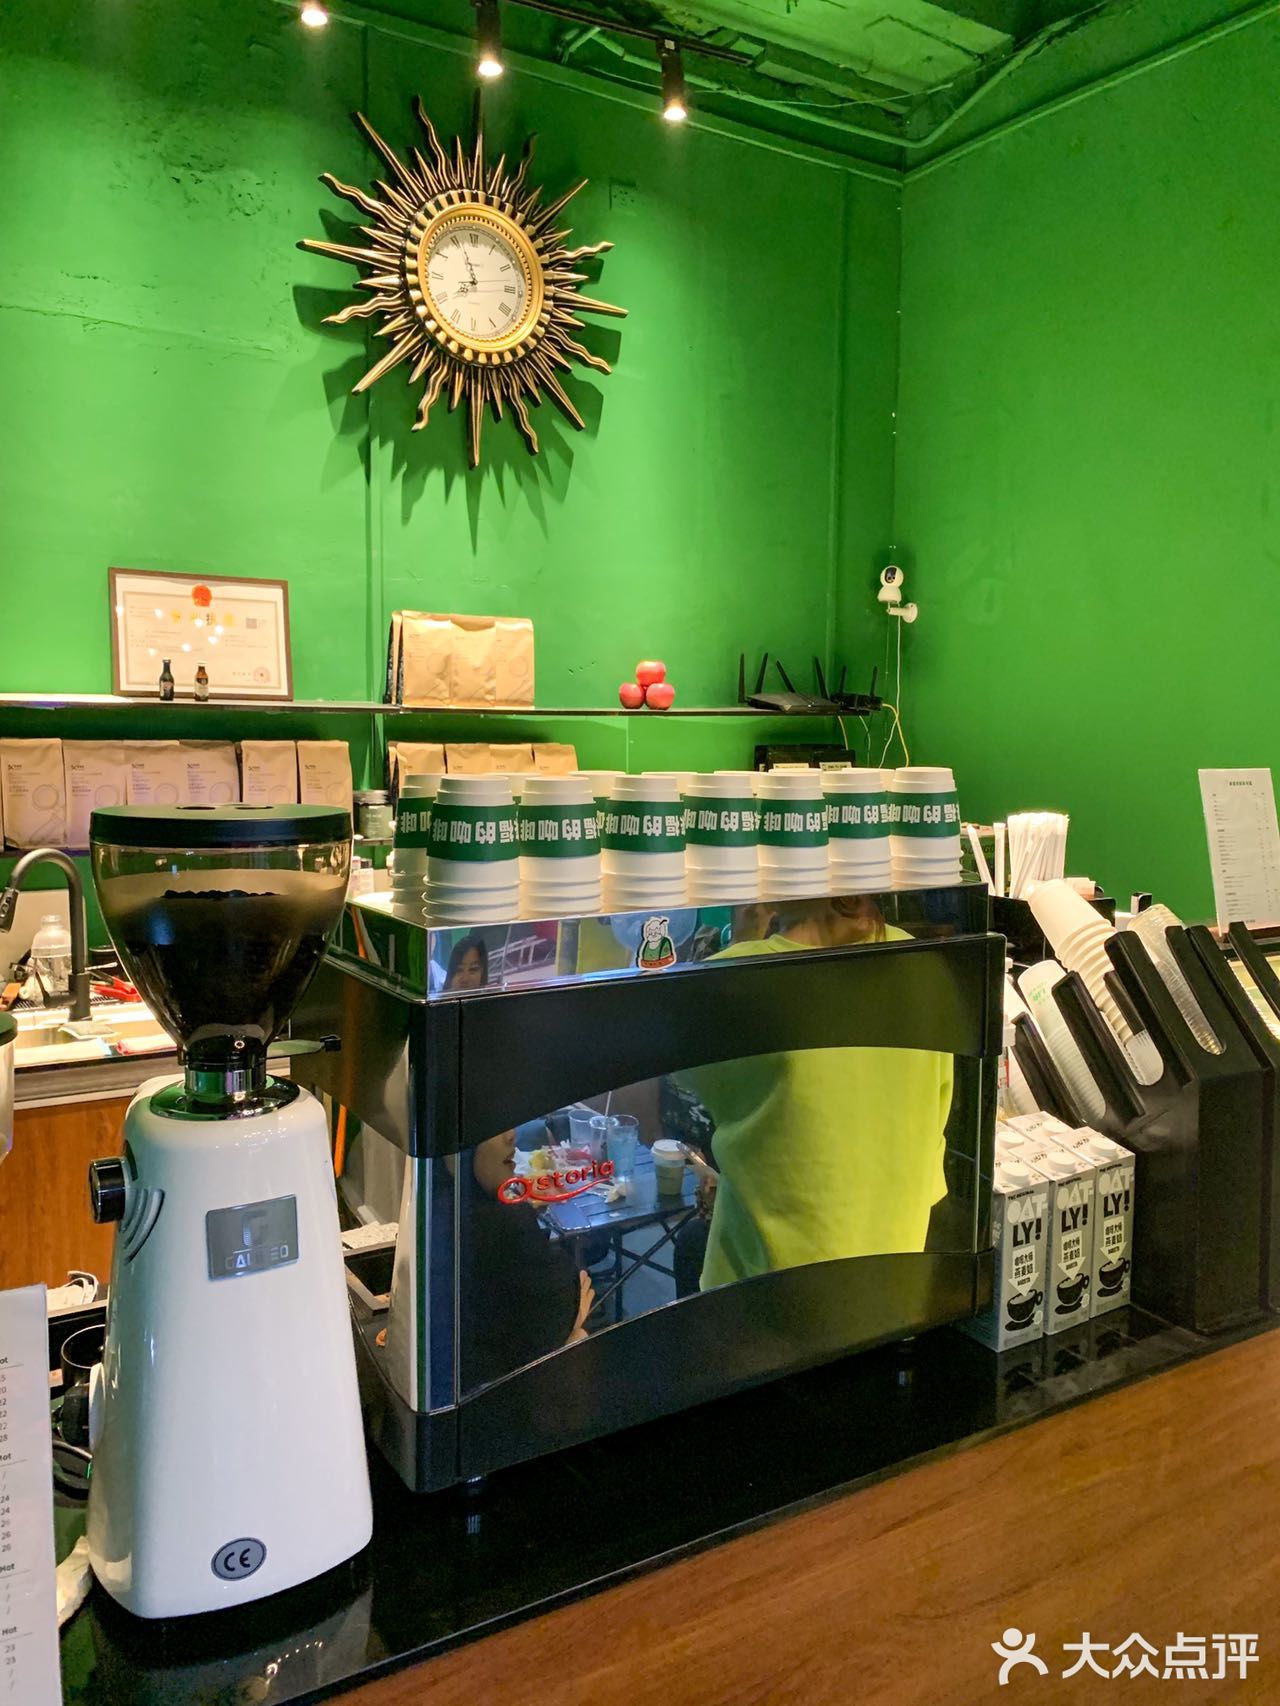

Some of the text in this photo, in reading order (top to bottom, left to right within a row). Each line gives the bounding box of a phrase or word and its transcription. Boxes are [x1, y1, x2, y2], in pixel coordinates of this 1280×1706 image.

[432, 818, 520, 845] 福的咖啡
[605, 813, 686, 837] 福的咖啡
[1103, 1189, 1130, 1218] LY!
[1061, 1203, 1088, 1233] LY!
[1013, 1217, 1042, 1248] LY!
[0, 1356, 8, 1364] ot
[223, 1547, 251, 1572] CE
[2, 1626, 17, 1636] Hot
